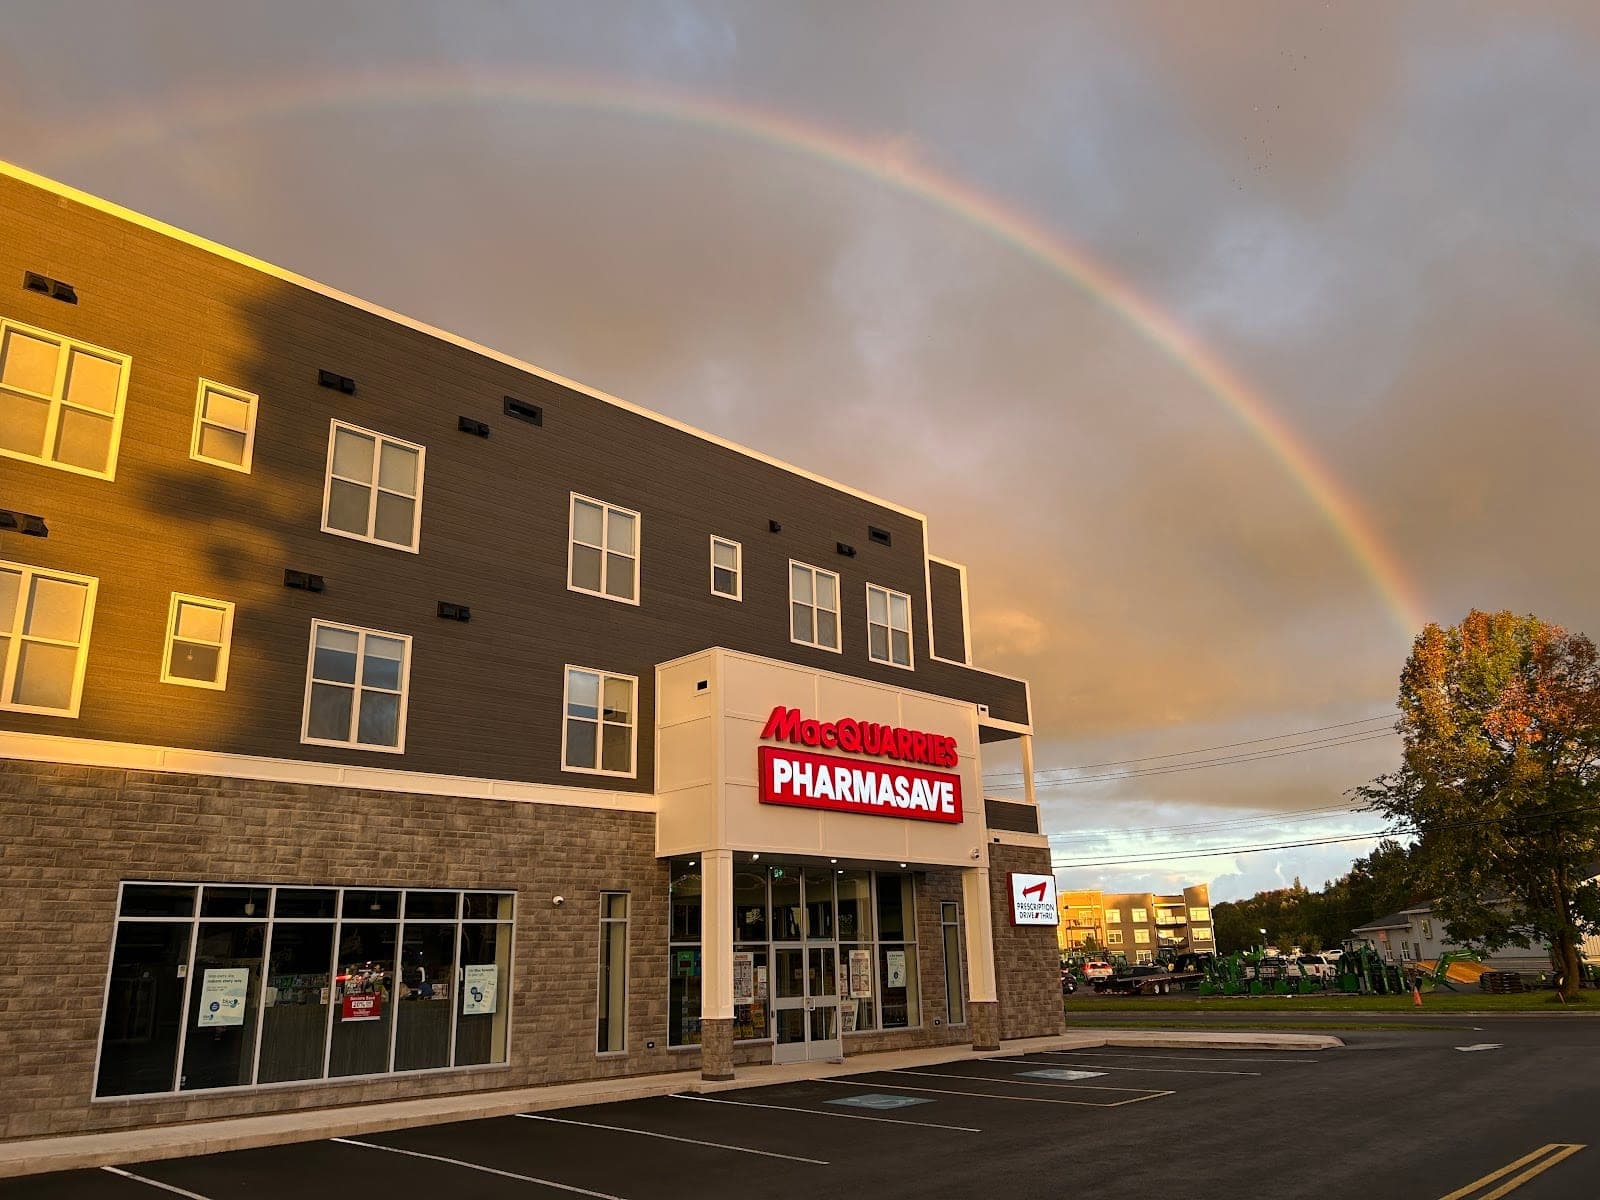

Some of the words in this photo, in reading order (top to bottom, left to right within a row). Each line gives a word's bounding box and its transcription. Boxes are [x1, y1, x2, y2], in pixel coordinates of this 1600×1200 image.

[760, 706, 959, 768] MacQUARRIES
[773, 758, 955, 814] PHARMASAVE
[1016, 902, 1054, 911] PRESCRIPTION
